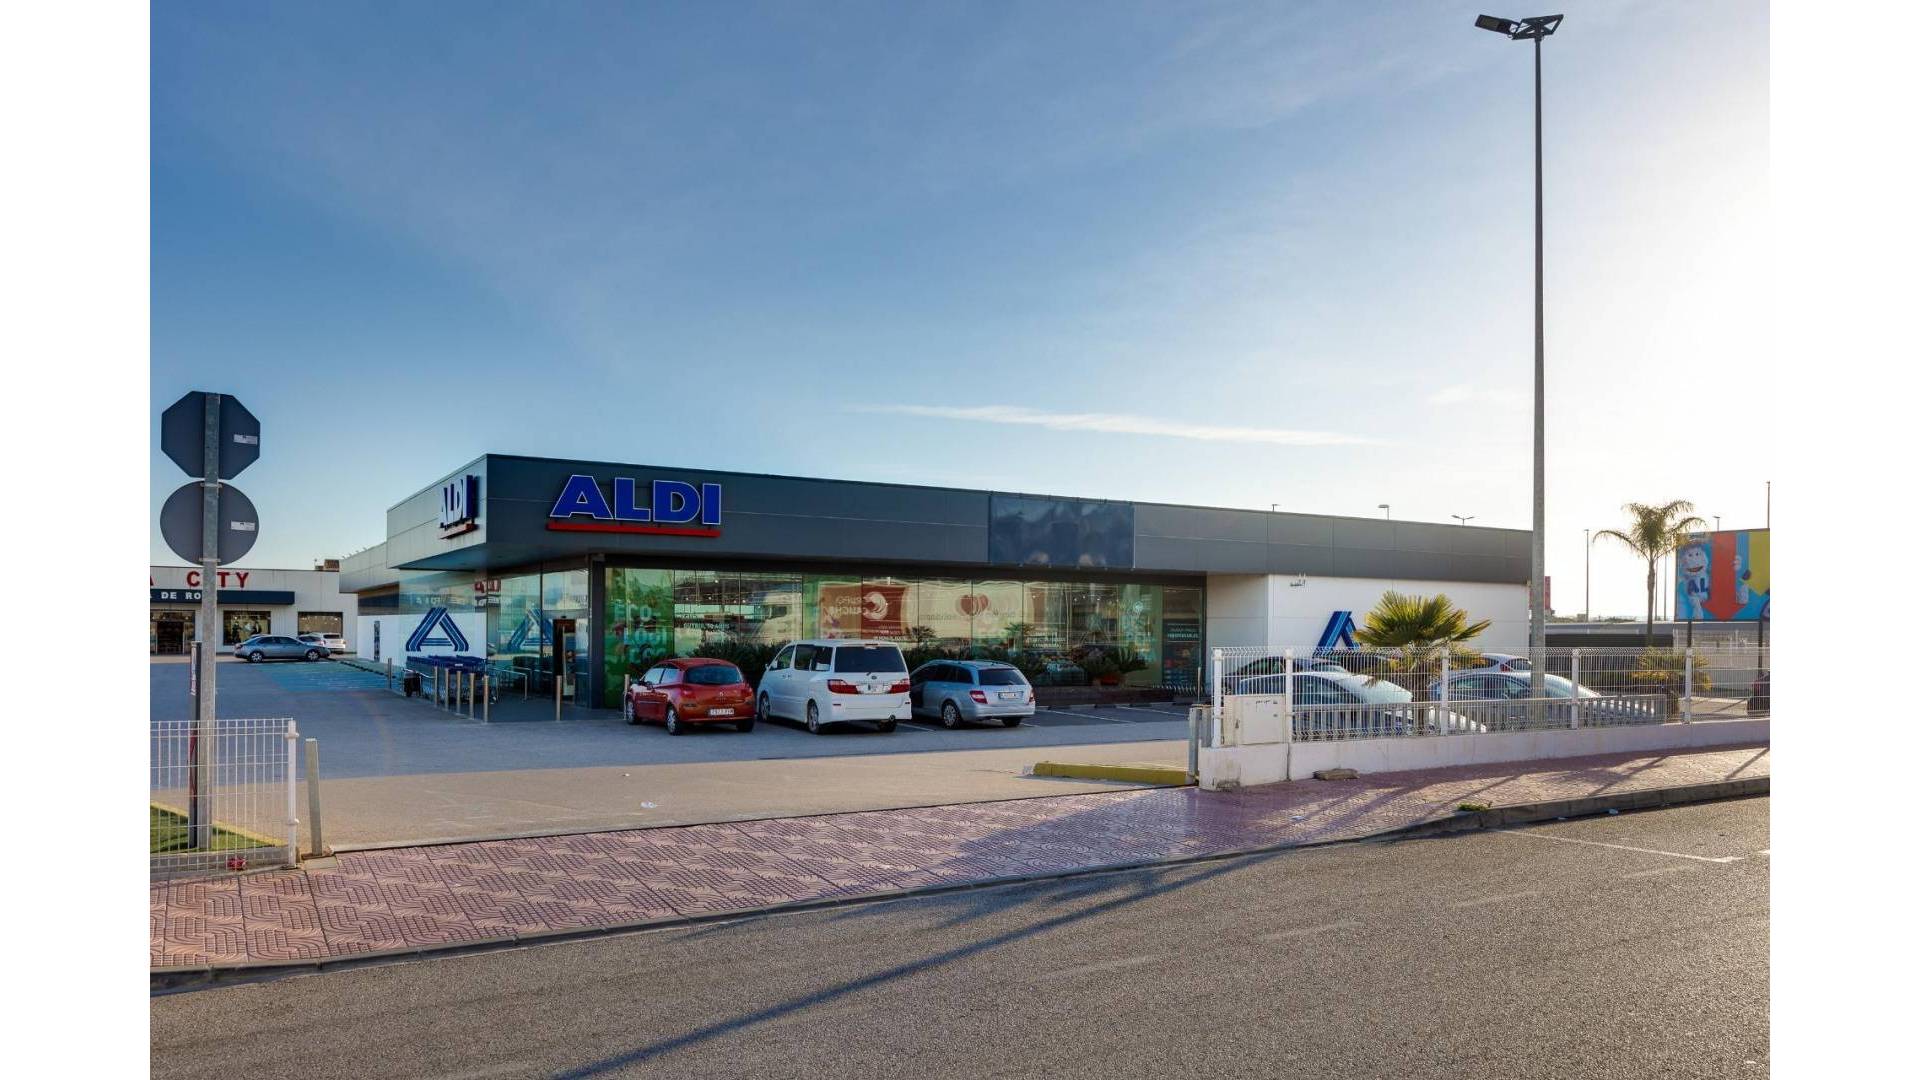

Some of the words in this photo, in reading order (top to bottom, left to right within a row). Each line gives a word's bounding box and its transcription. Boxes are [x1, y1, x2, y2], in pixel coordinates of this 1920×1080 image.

[440, 475, 474, 526] ALDI
[550, 474, 722, 525] ALDI
[161, 591, 177, 599] DE
[186, 571, 249, 588] CTY
